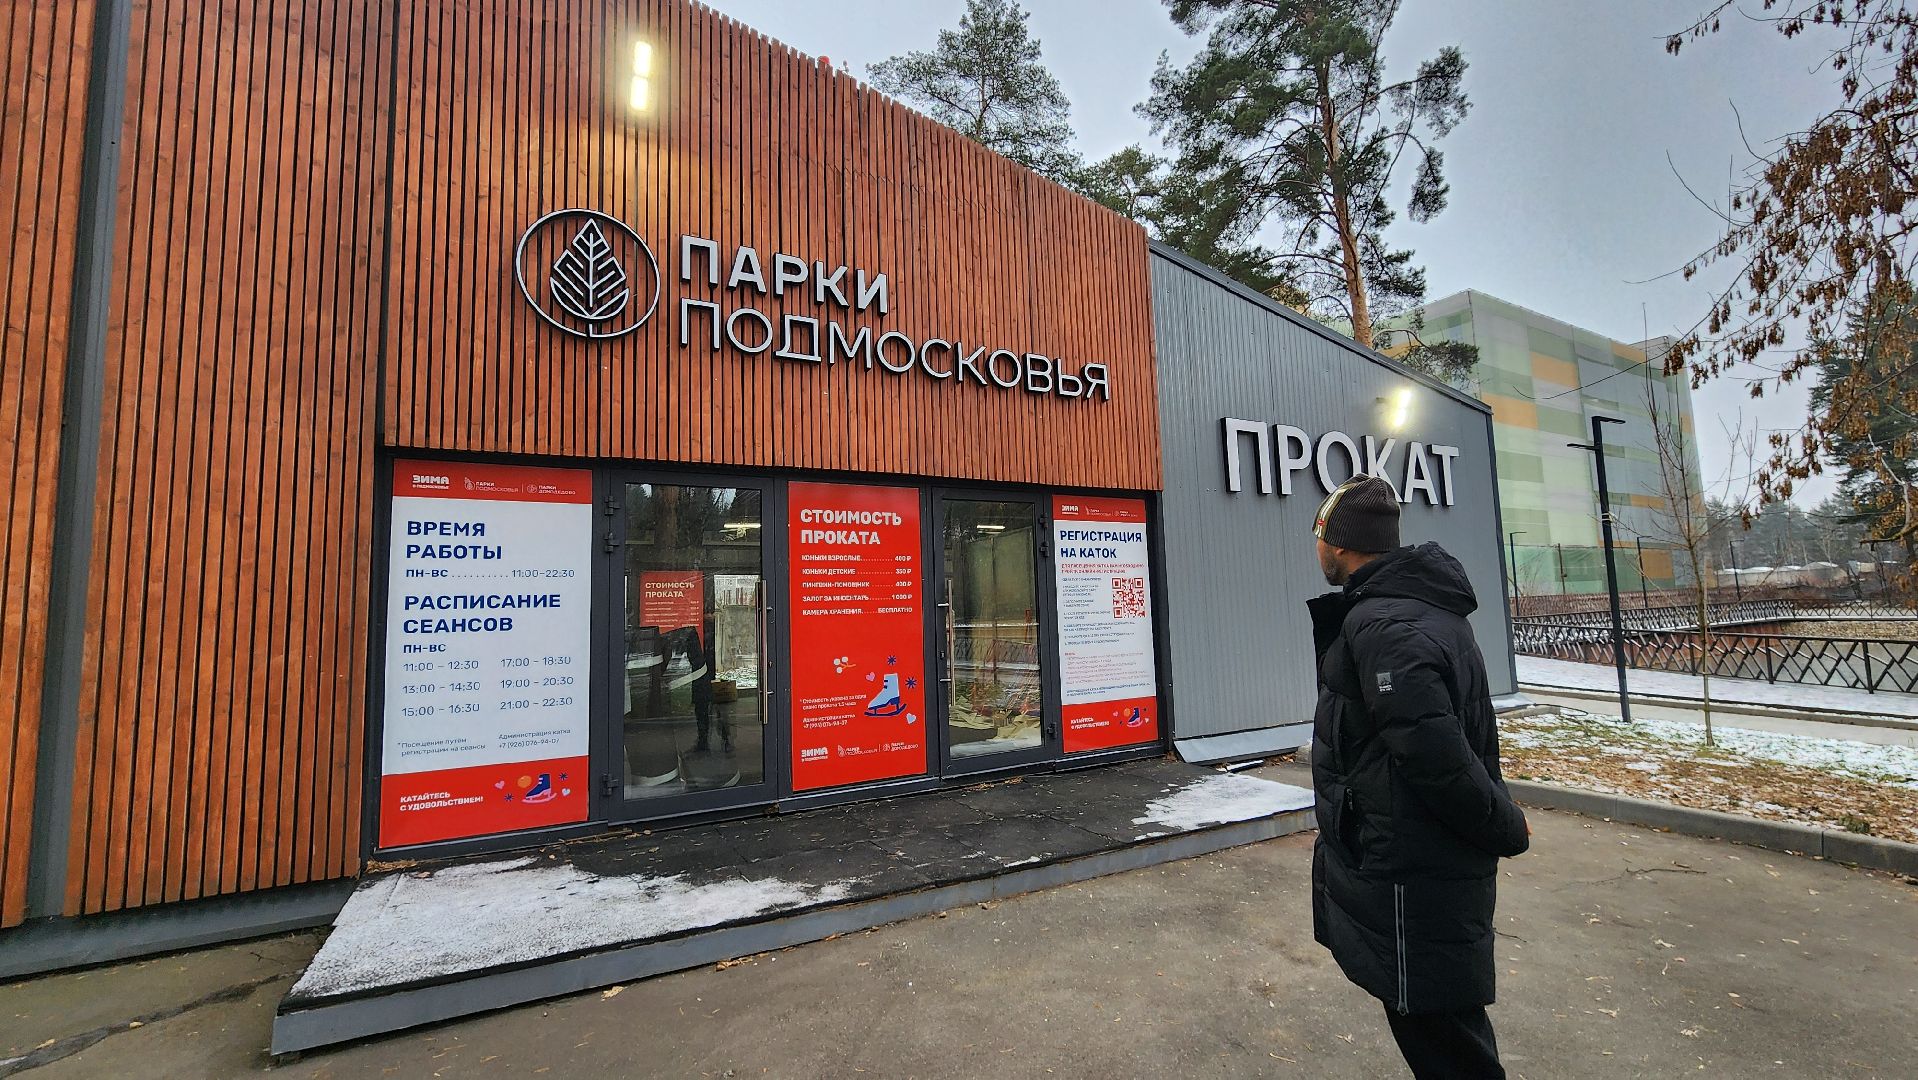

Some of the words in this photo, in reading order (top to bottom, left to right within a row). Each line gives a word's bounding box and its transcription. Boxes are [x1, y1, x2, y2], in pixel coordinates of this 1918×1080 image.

[680, 234, 888, 315] ПАРКИ
[679, 297, 1110, 401] ПОДМОСКОВЬЯ
[1220, 417, 1459, 506] ПРОКАТ
[413, 475, 450, 484] ЗИМА
[800, 509, 902, 525] СТОИМОСТЬ
[407, 521, 485, 537] ВРЕМЯ
[801, 530, 880, 544] ПРОКАТА
[1060, 531, 1142, 543] РЕГИСТРАЦИЯ
[406, 544, 502, 559] РАБОТЫ
[1061, 548, 1076, 558] НА
[1080, 548, 1117, 558] КАТОК
[406, 569, 448, 578] ПН-ВС
[404, 594, 561, 610] РАСПИСАНИЕ
[403, 618, 513, 634] СЕАНСОВ
[403, 644, 446, 653] ПН-ВС
[404, 662, 434, 672] 11:00
[448, 660, 479, 670] 12:30
[501, 658, 530, 668] 17:00
[543, 656, 571, 666] 18:30
[403, 684, 435, 694] 13:00
[449, 682, 481, 692] 14:30
[501, 679, 530, 688] 19:00
[543, 677, 574, 686] 20:30
[500, 700, 530, 710] 21:00
[542, 697, 573, 707] 22:30
[402, 706, 434, 716] 15:00
[449, 704, 480, 714] 16:30
[801, 747, 828, 757] ЗИМА
[400, 792, 450, 803] КАТАЙТЕСЬ
